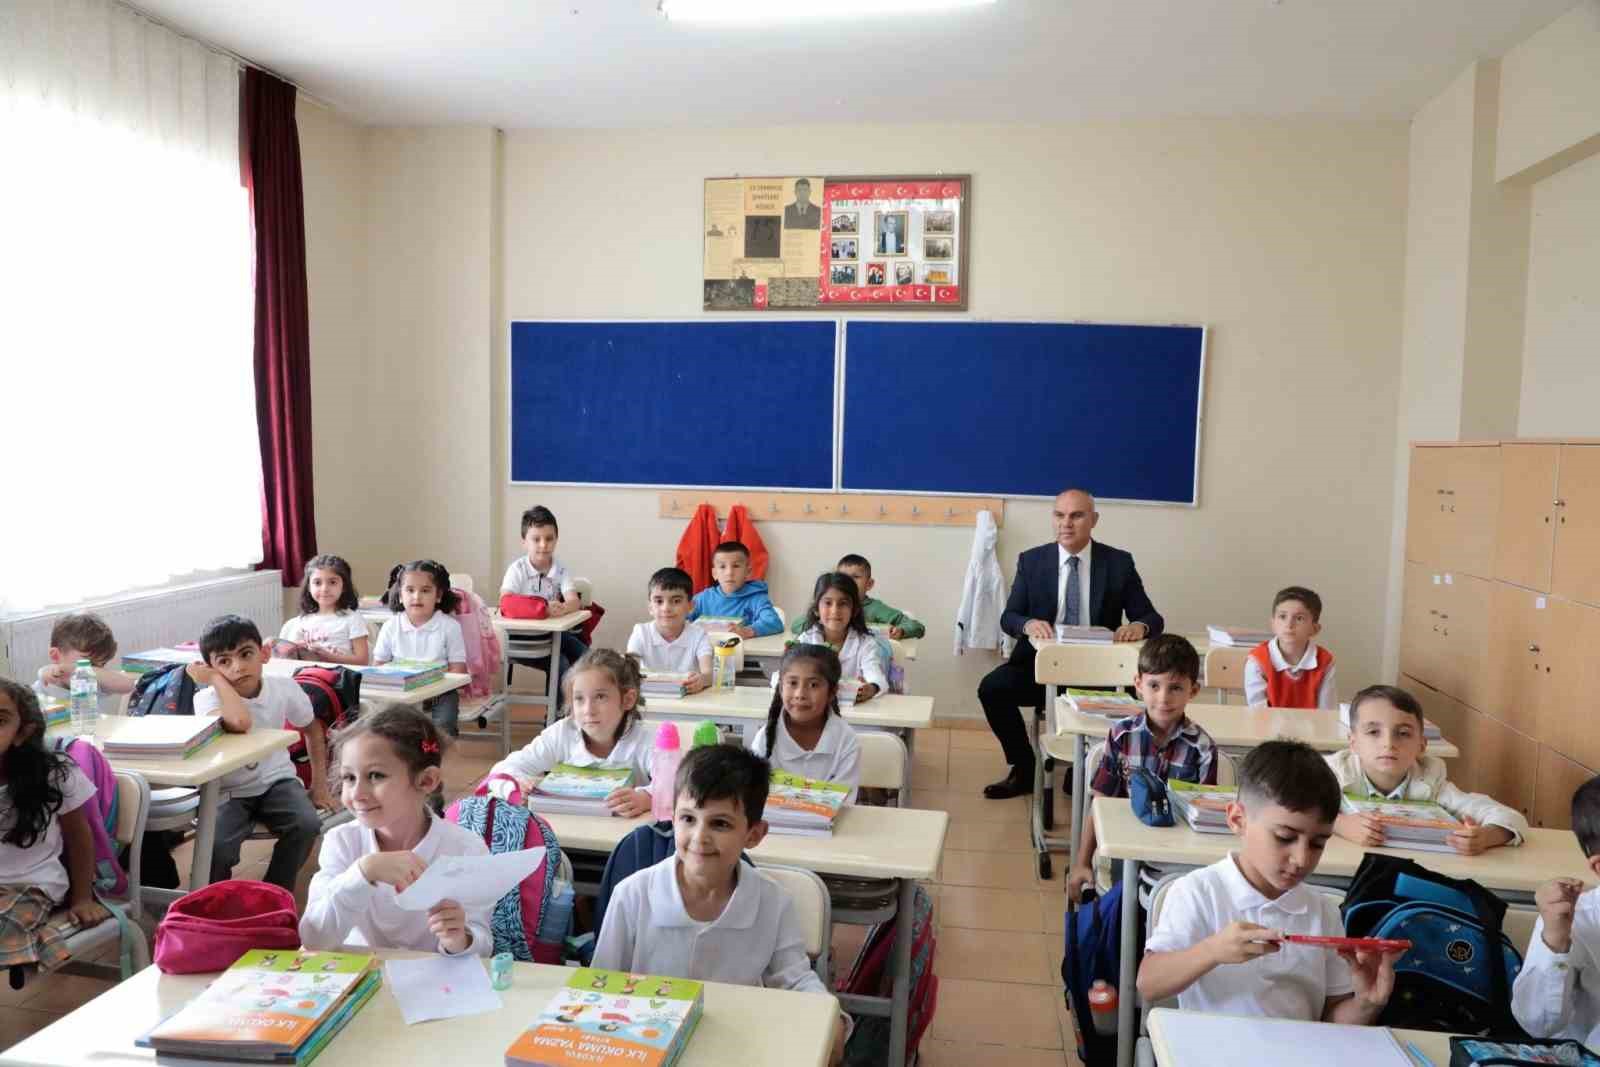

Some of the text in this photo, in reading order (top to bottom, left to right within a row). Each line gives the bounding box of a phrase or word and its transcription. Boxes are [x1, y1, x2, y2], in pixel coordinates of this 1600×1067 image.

[532, 1035, 648, 1063] İLK OKUMA YAZMA
